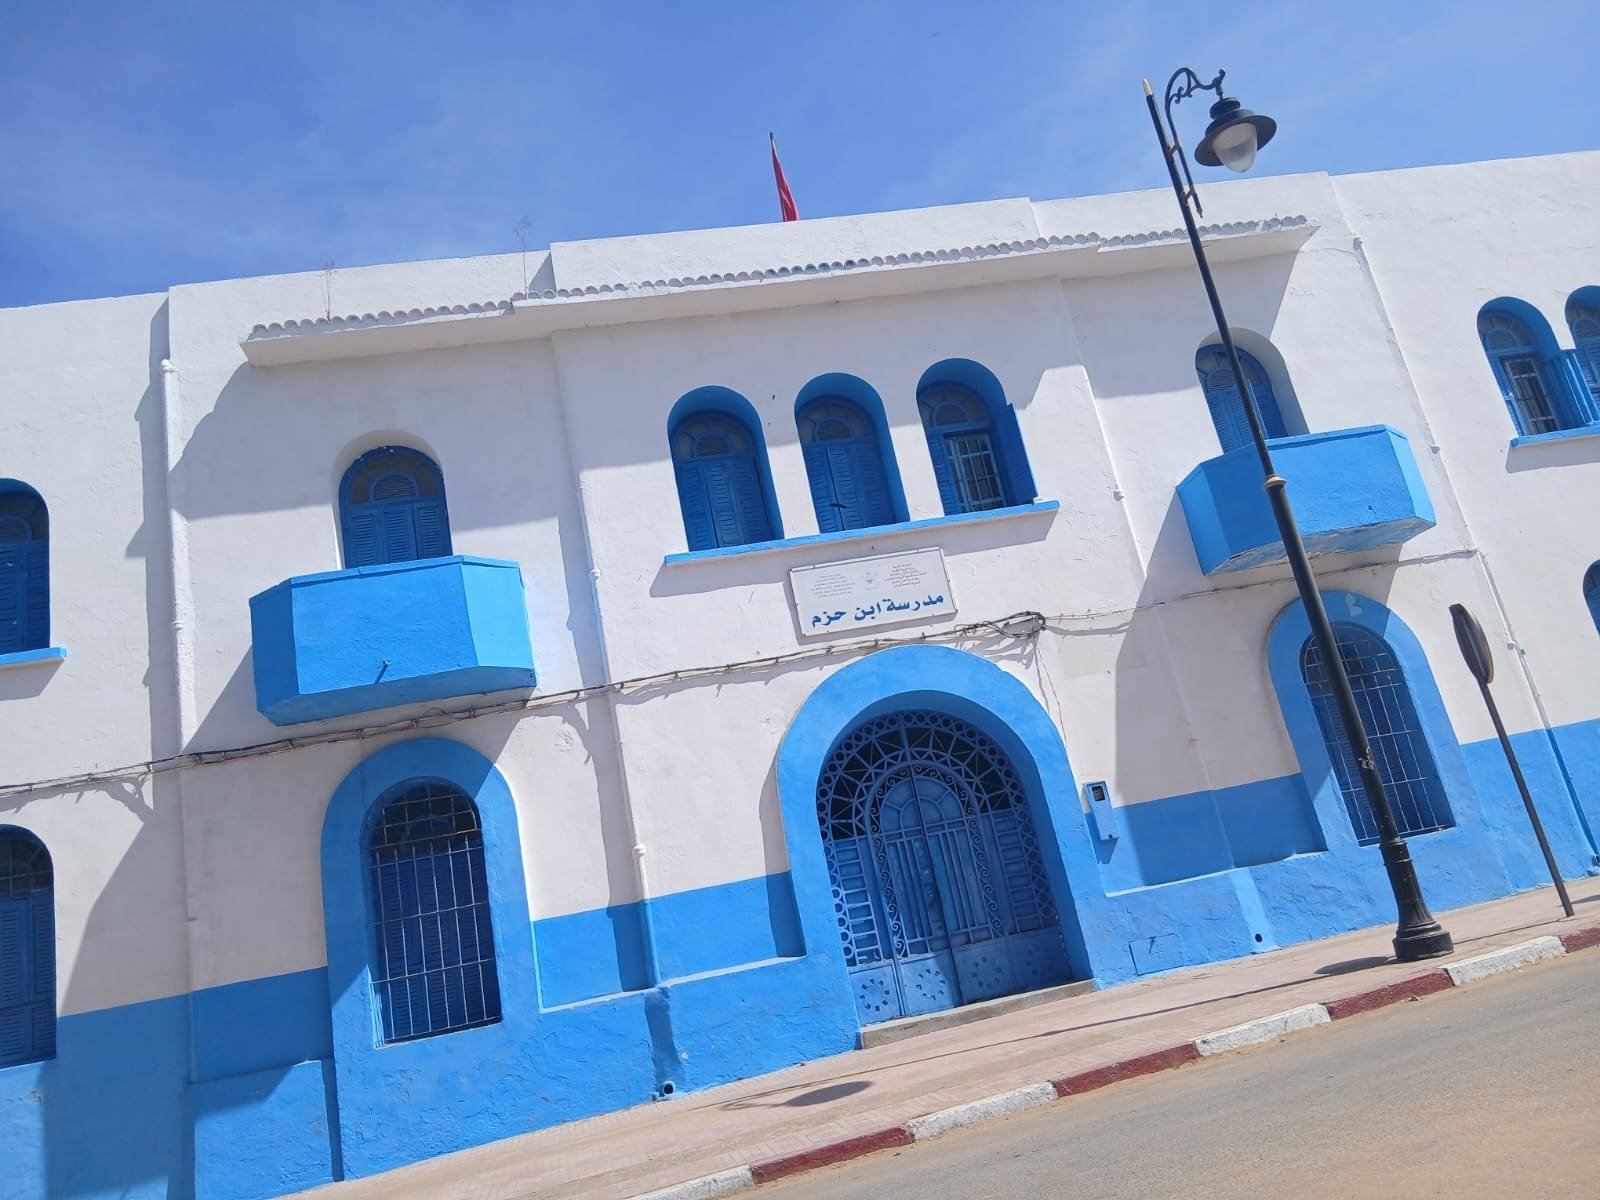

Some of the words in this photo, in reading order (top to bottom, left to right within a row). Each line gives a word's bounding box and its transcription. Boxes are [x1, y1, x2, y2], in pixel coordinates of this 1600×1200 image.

[854, 602, 882, 620] ابن
[882, 594, 944, 612] مدرسة
[811, 609, 847, 628] حزم
